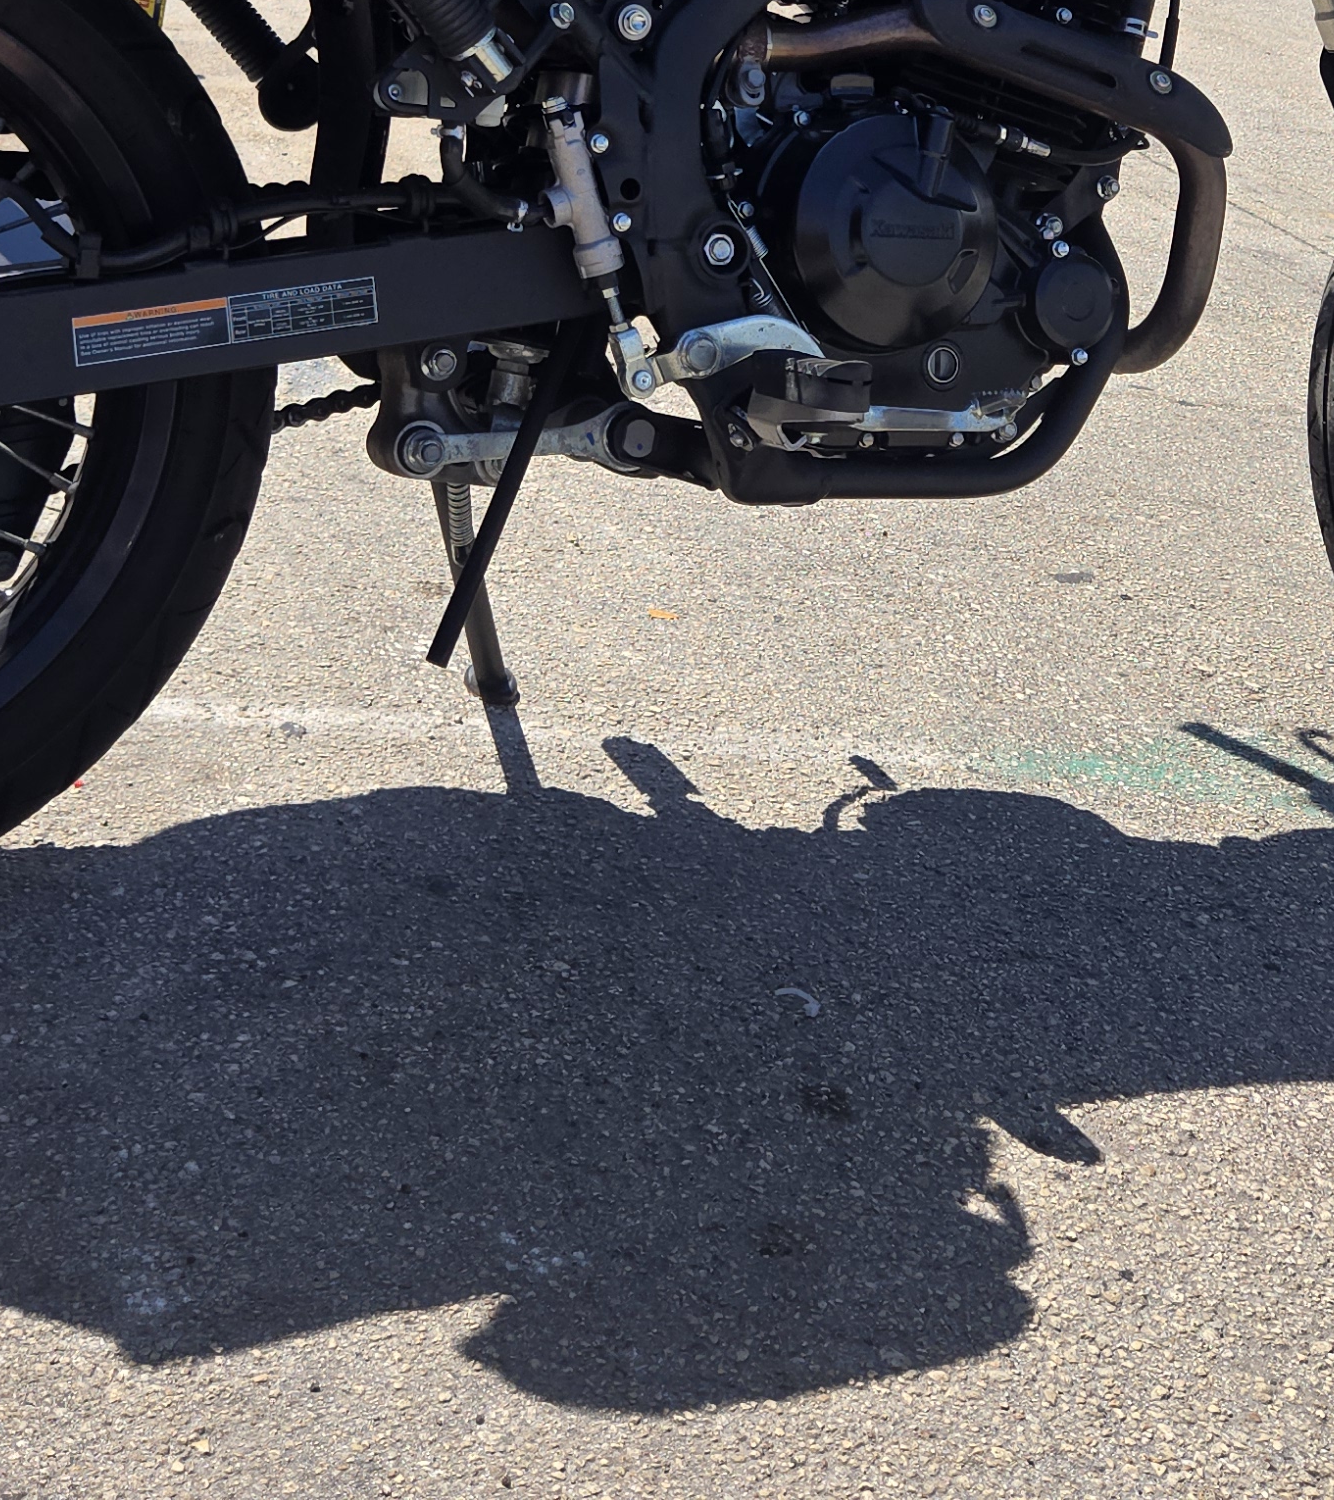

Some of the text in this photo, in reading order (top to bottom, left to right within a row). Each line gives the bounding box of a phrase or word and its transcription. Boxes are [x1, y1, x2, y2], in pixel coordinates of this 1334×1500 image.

[870, 219, 955, 240] Kawasaki
[262, 283, 343, 300] TIRE AND LOAD DATA
[133, 306, 177, 319] WARNING
